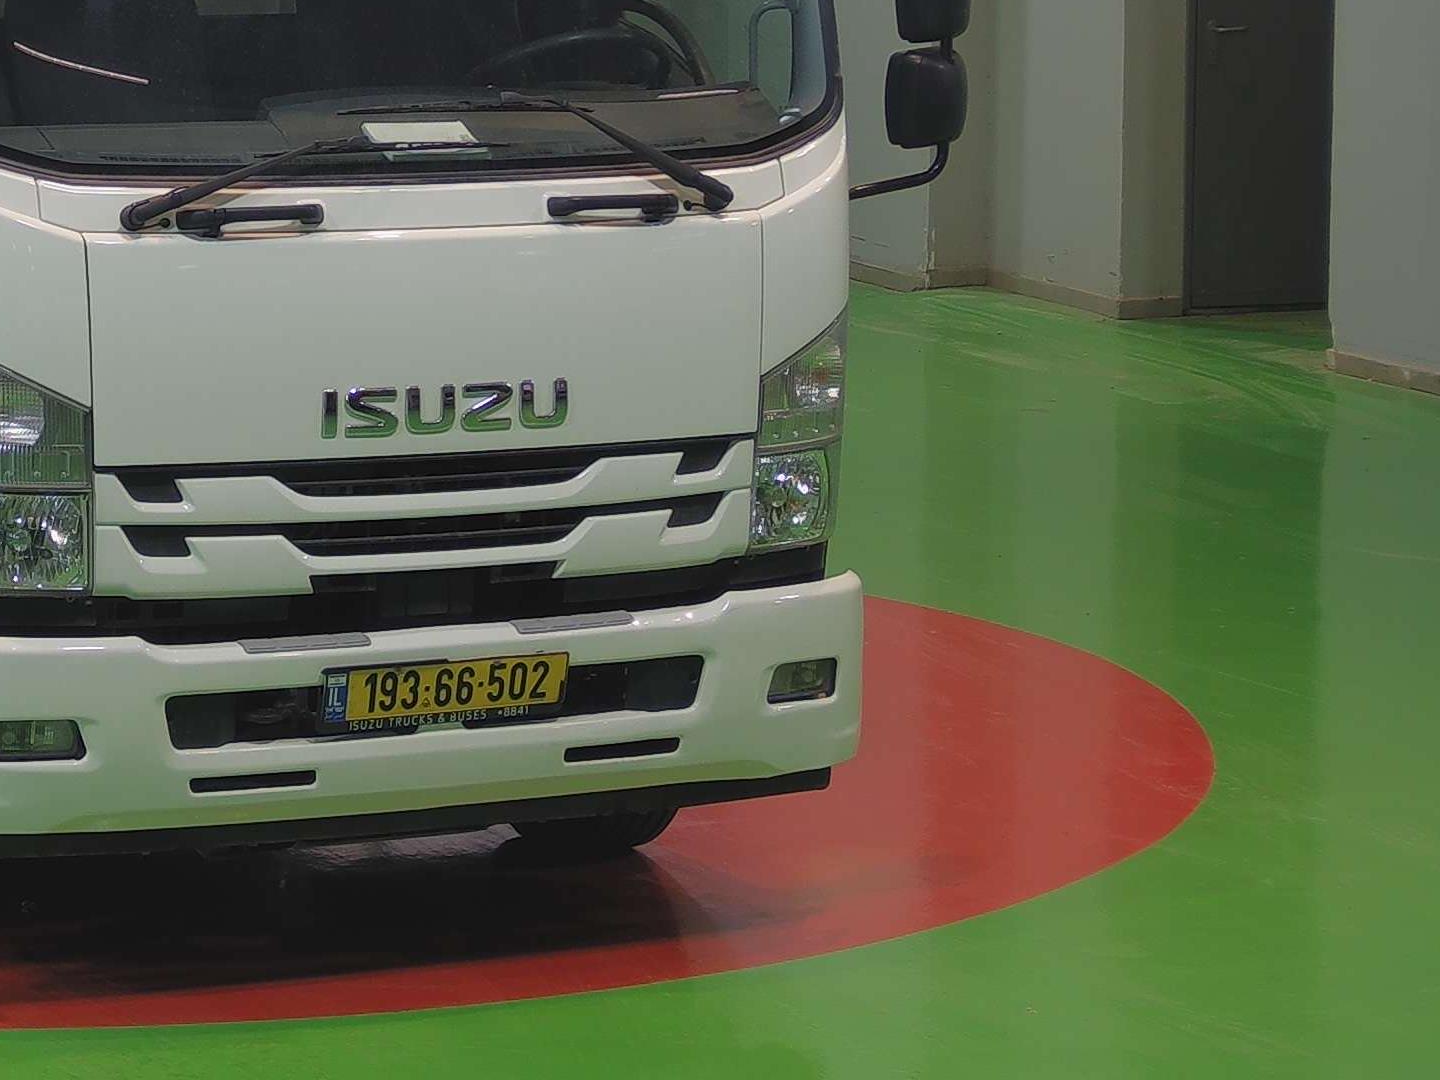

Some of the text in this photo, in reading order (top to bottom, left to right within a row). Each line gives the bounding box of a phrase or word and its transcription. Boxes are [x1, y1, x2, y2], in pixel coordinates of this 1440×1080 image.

[320, 376, 569, 439] ISUZU
[328, 687, 342, 707] IL
[348, 708, 488, 732] ISUZU TRUCKS & BUSES
